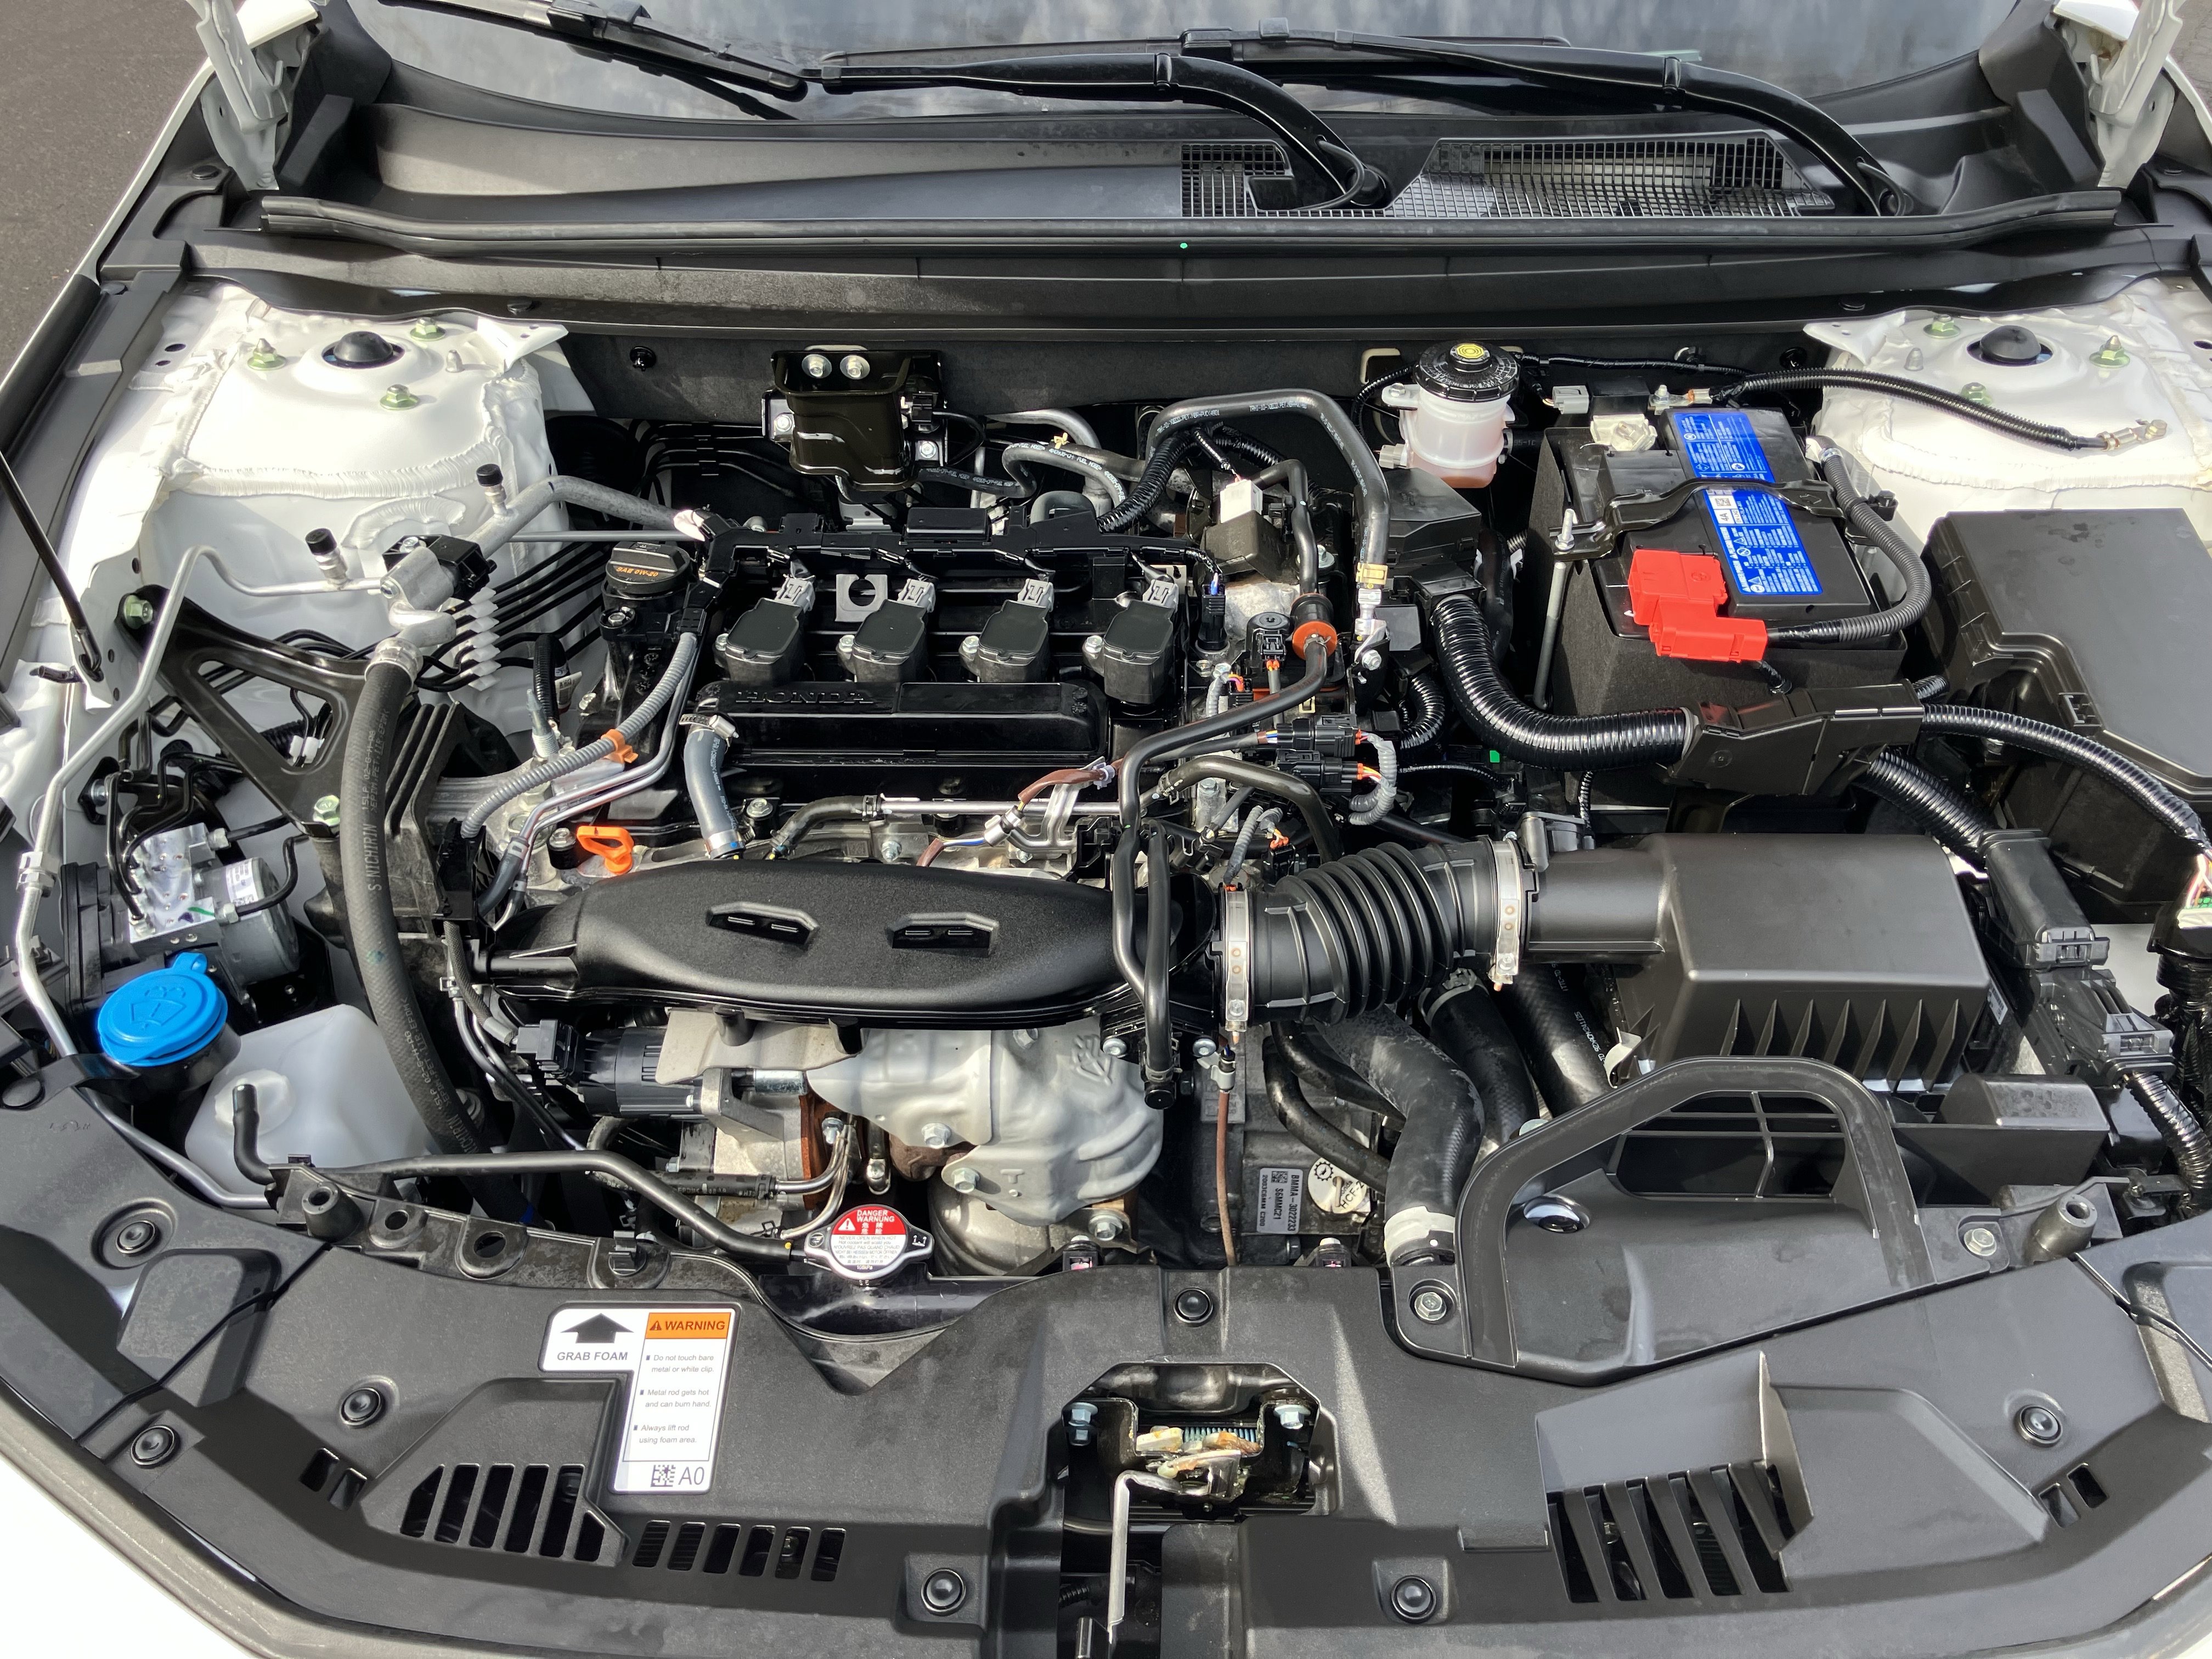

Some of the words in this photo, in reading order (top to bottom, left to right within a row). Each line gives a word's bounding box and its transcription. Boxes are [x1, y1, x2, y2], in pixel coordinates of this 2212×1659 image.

[1719, 512, 1729, 522] 4A
[736, 692, 874, 704] HONDA
[1340, 1180, 1365, 1209] HCF-2
[665, 1321, 725, 1330] WARNING
[557, 1352, 590, 1361] GRAB
[594, 1352, 628, 1361] FOAM
[639, 1436, 657, 1444] using
[679, 1467, 705, 1485] A0
